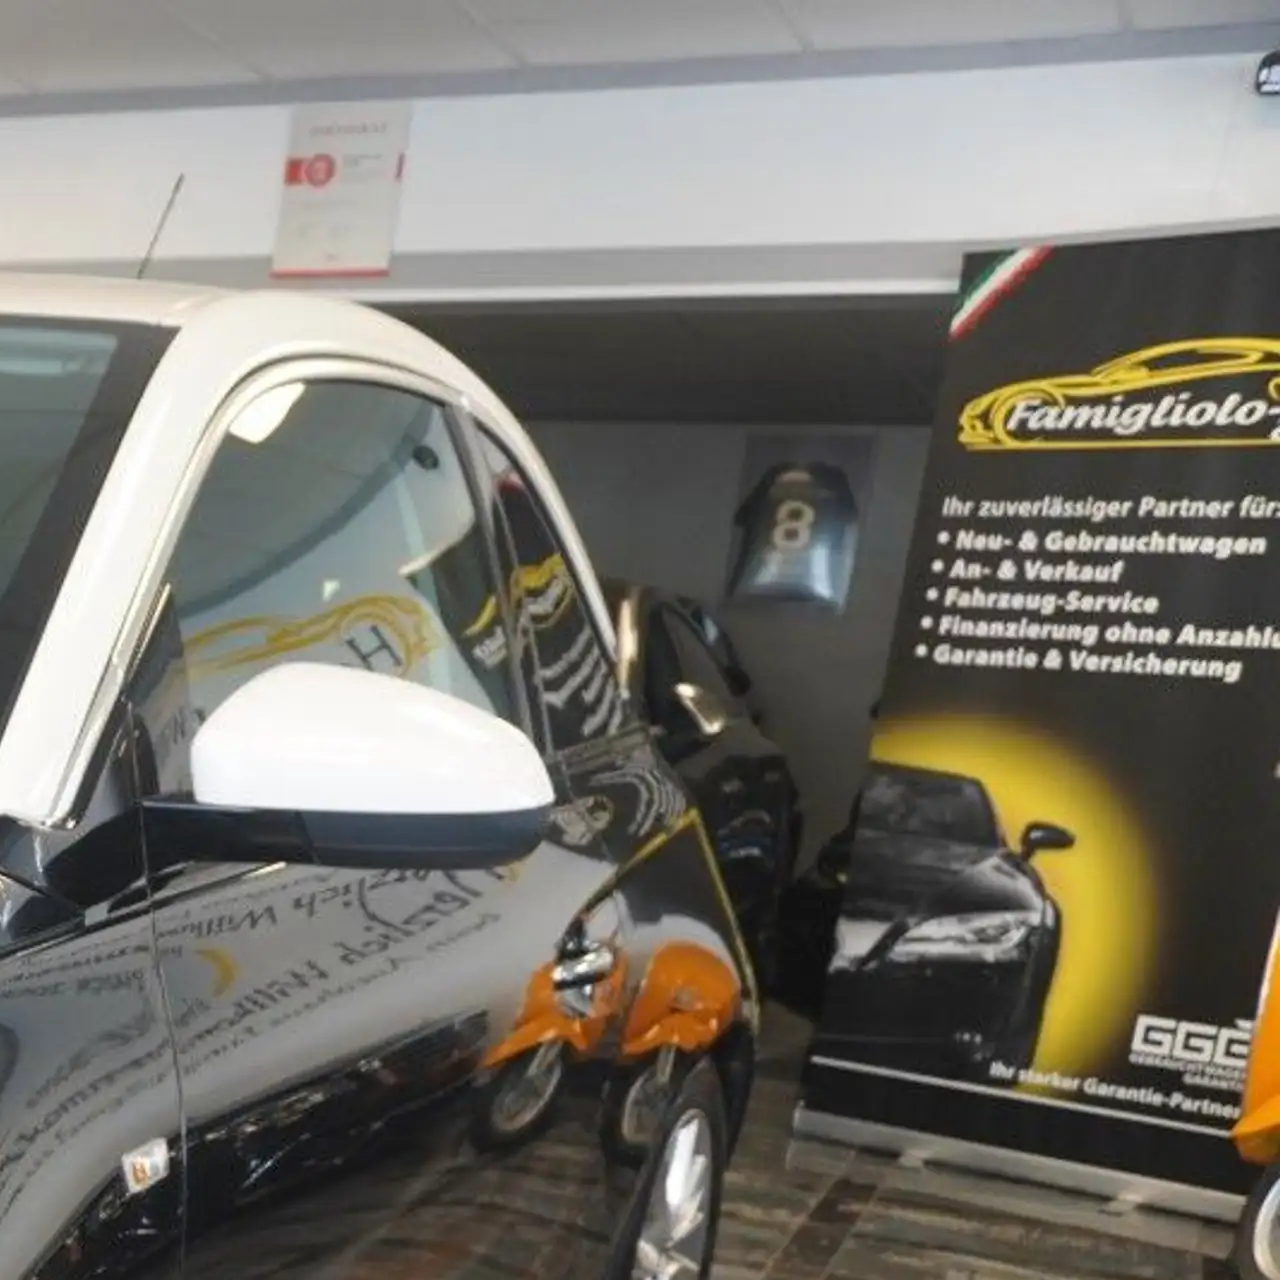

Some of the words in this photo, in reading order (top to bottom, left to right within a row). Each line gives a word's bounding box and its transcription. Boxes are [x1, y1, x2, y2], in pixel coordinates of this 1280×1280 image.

[941, 494, 974, 518] Ihr
[977, 494, 1132, 524] zuverlässiger
[1137, 495, 1234, 519] Partner
[1239, 494, 1280, 519] für:
[955, 530, 1013, 552] Neu-
[1017, 529, 1040, 553] &
[1043, 529, 1268, 560] Gebrauchtwagen
[948, 557, 992, 580] An-
[996, 558, 1018, 581] &
[1023, 558, 1126, 583] Verkauf
[943, 586, 1160, 616] Fahrzeug-Service
[937, 614, 1100, 648] Finanzierung
[1104, 620, 1173, 646] ohne
[932, 643, 1039, 670] Garantie
[1042, 648, 1063, 670] &
[1069, 649, 1244, 684] Versicherung
[989, 1060, 1016, 1079] Ihr
[1083, 1076, 1241, 1120] Garantie-Partner
